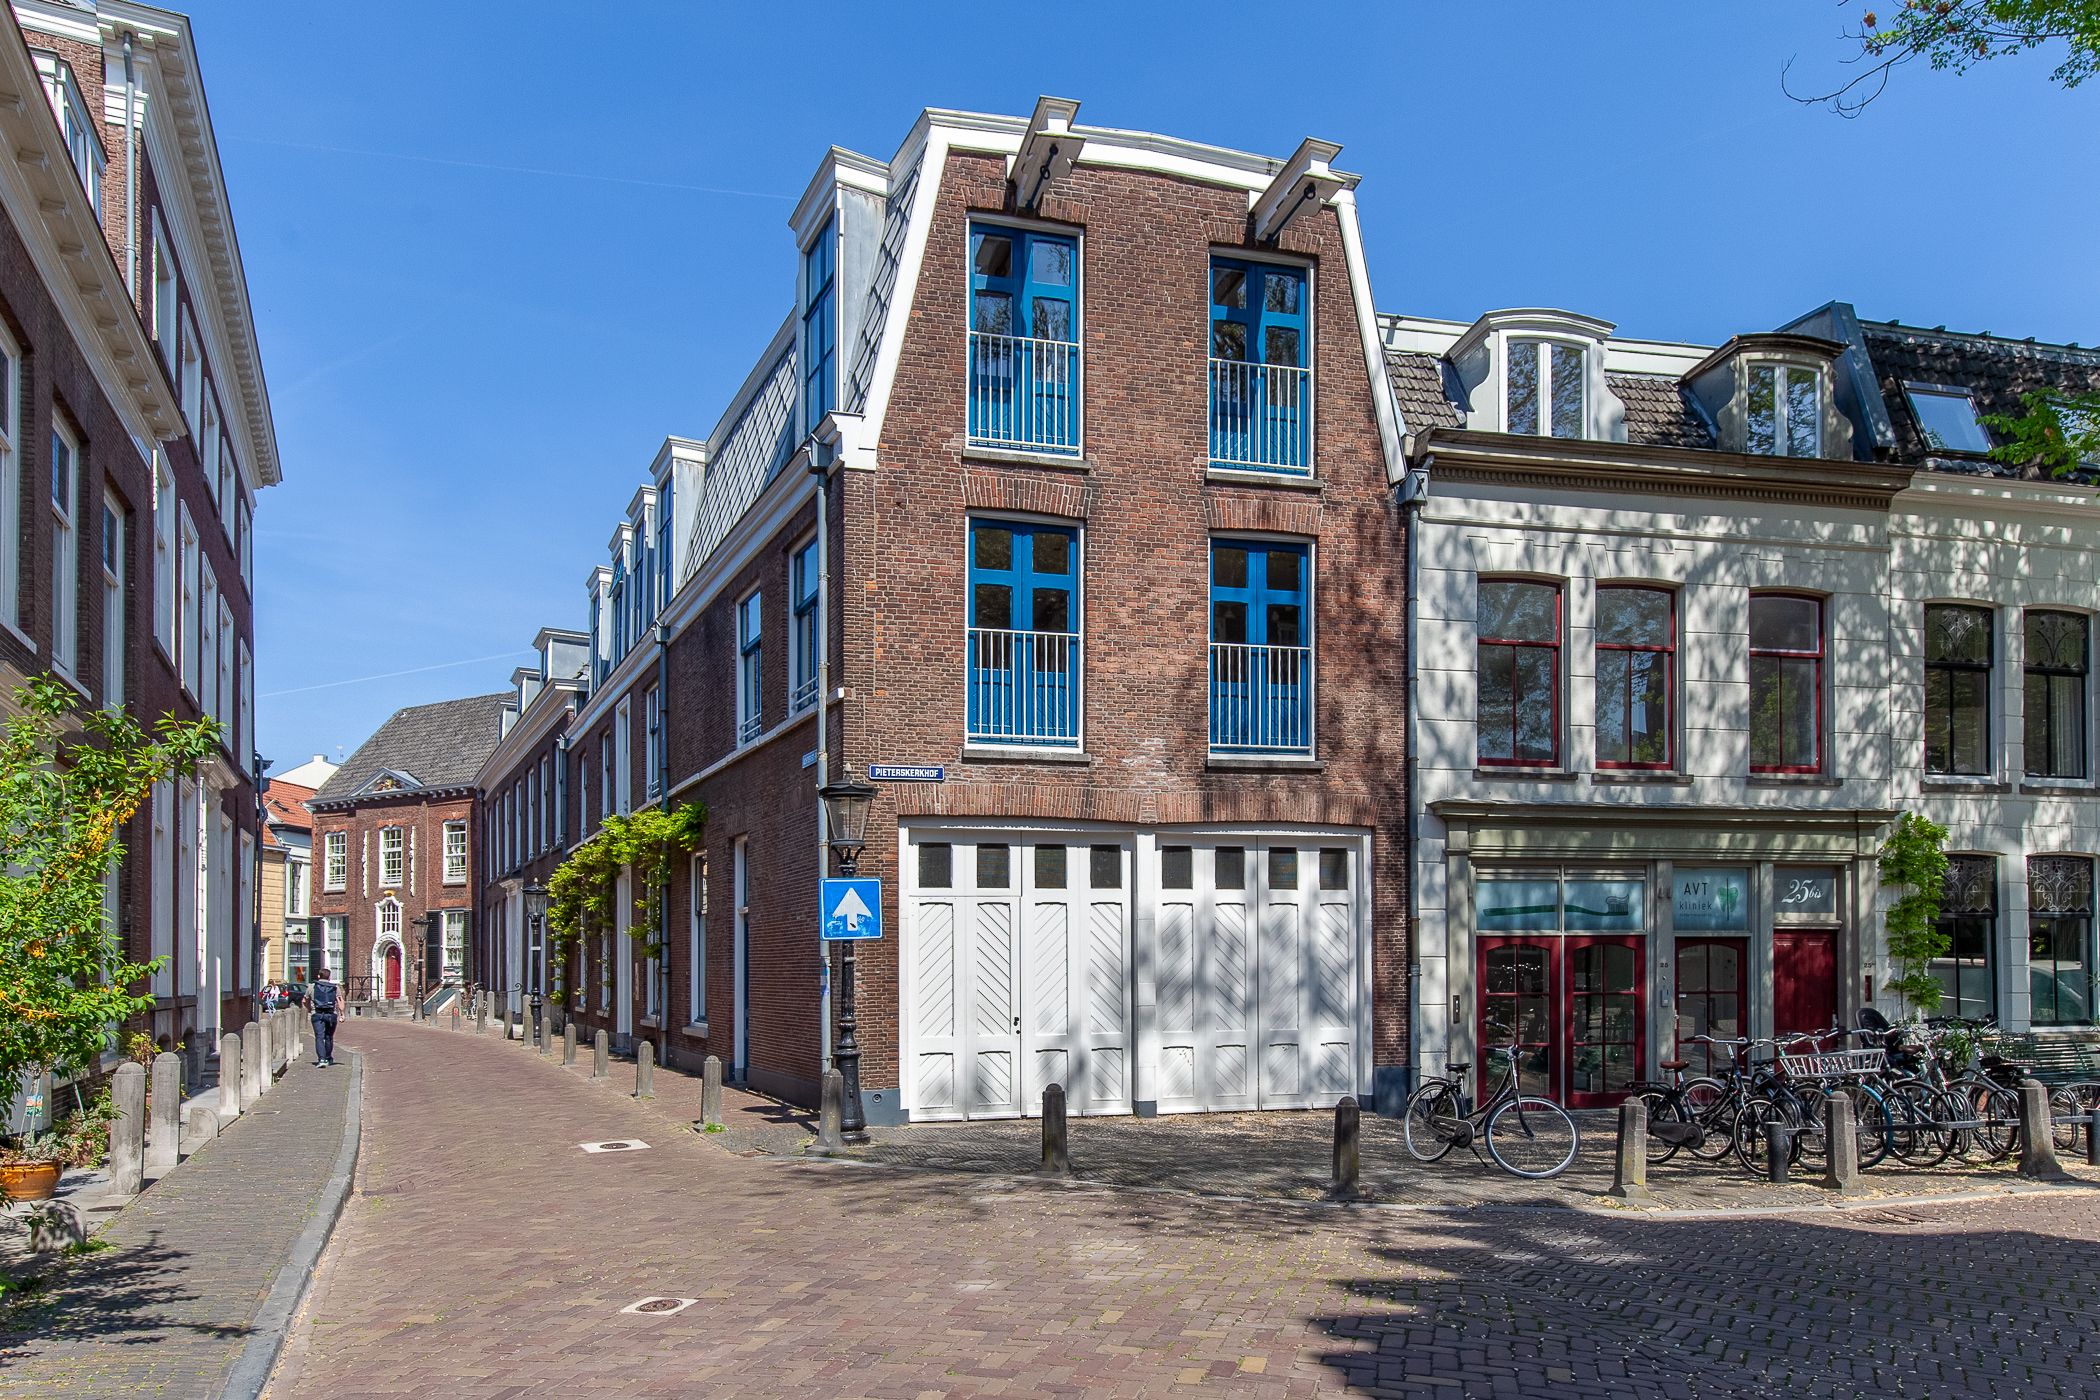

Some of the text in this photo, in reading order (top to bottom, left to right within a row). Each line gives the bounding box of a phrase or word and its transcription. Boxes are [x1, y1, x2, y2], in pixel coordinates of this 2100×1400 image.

[875, 767, 939, 778] PIETERSKERKHOF
[1684, 882, 1708, 895] AVT
[1680, 901, 1712, 910] kliniek
